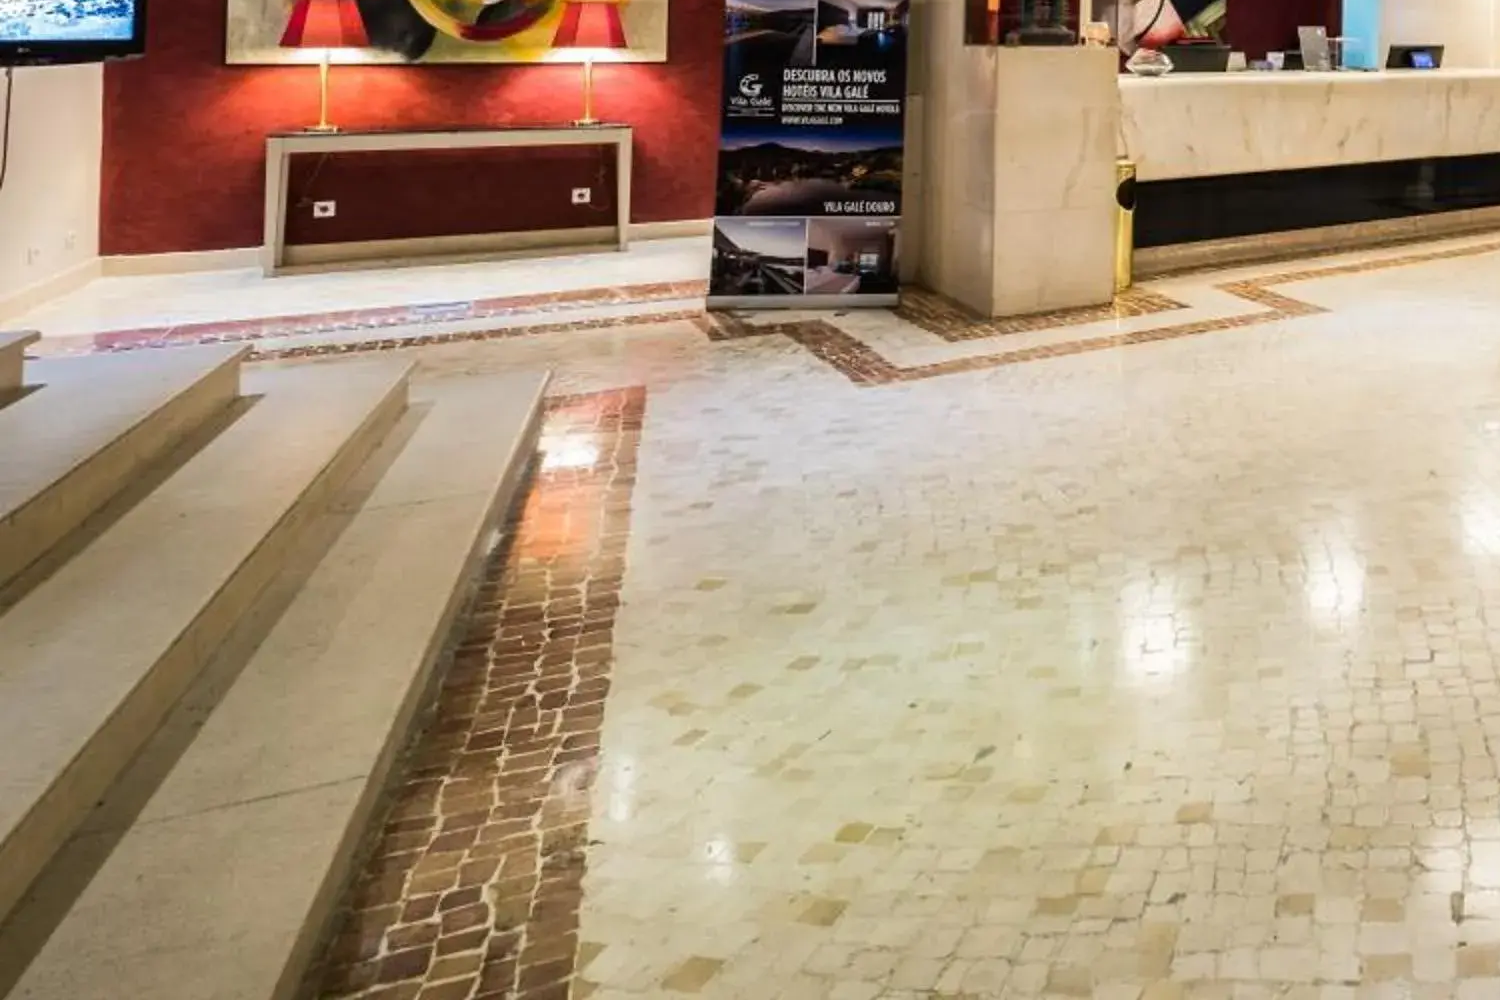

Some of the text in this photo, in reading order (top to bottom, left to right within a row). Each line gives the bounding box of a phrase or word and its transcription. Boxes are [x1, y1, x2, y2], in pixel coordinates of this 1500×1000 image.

[783, 69, 887, 84] DESCUBRA OS NOVOS
[820, 85, 842, 98] VILA
[824, 201, 843, 213] VILA
